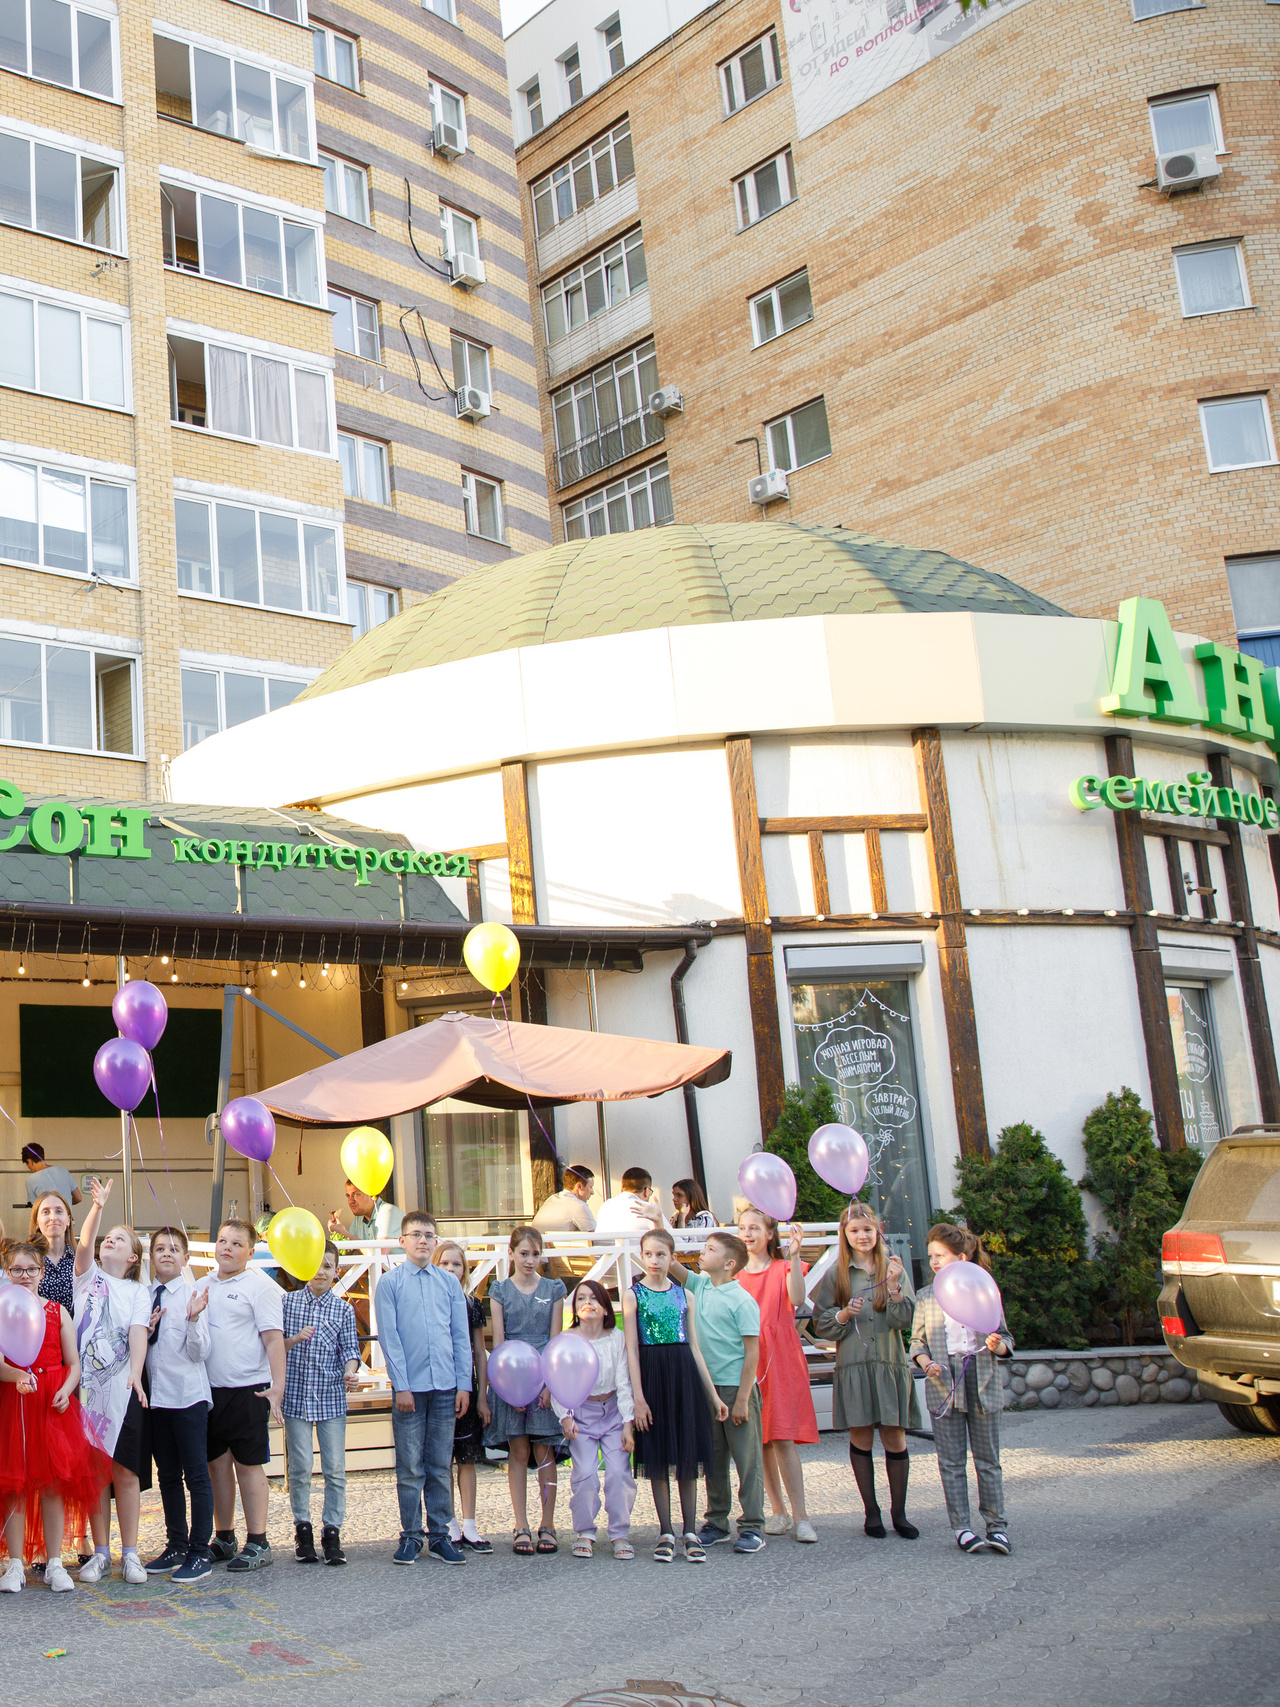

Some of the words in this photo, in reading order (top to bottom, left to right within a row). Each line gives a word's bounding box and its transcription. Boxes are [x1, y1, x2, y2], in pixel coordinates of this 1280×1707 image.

[830, 55, 849, 77] ДО
[1069, 770, 1280, 831] семейное
[170, 835, 473, 887] кондитерская
[820, 1042, 851, 1060] УЮТНАЯ
[851, 1038, 887, 1051] ИГРОВАЯ
[841, 1050, 877, 1066] ВЕСЕЛЫМ
[838, 1062, 882, 1080] АНИМАТОРОМ
[872, 1092, 910, 1107] ЗАВТРАК
[872, 1103, 894, 1116] ЦЕЛЫЙ
[894, 1106, 910, 1120] ДЕНЬ
